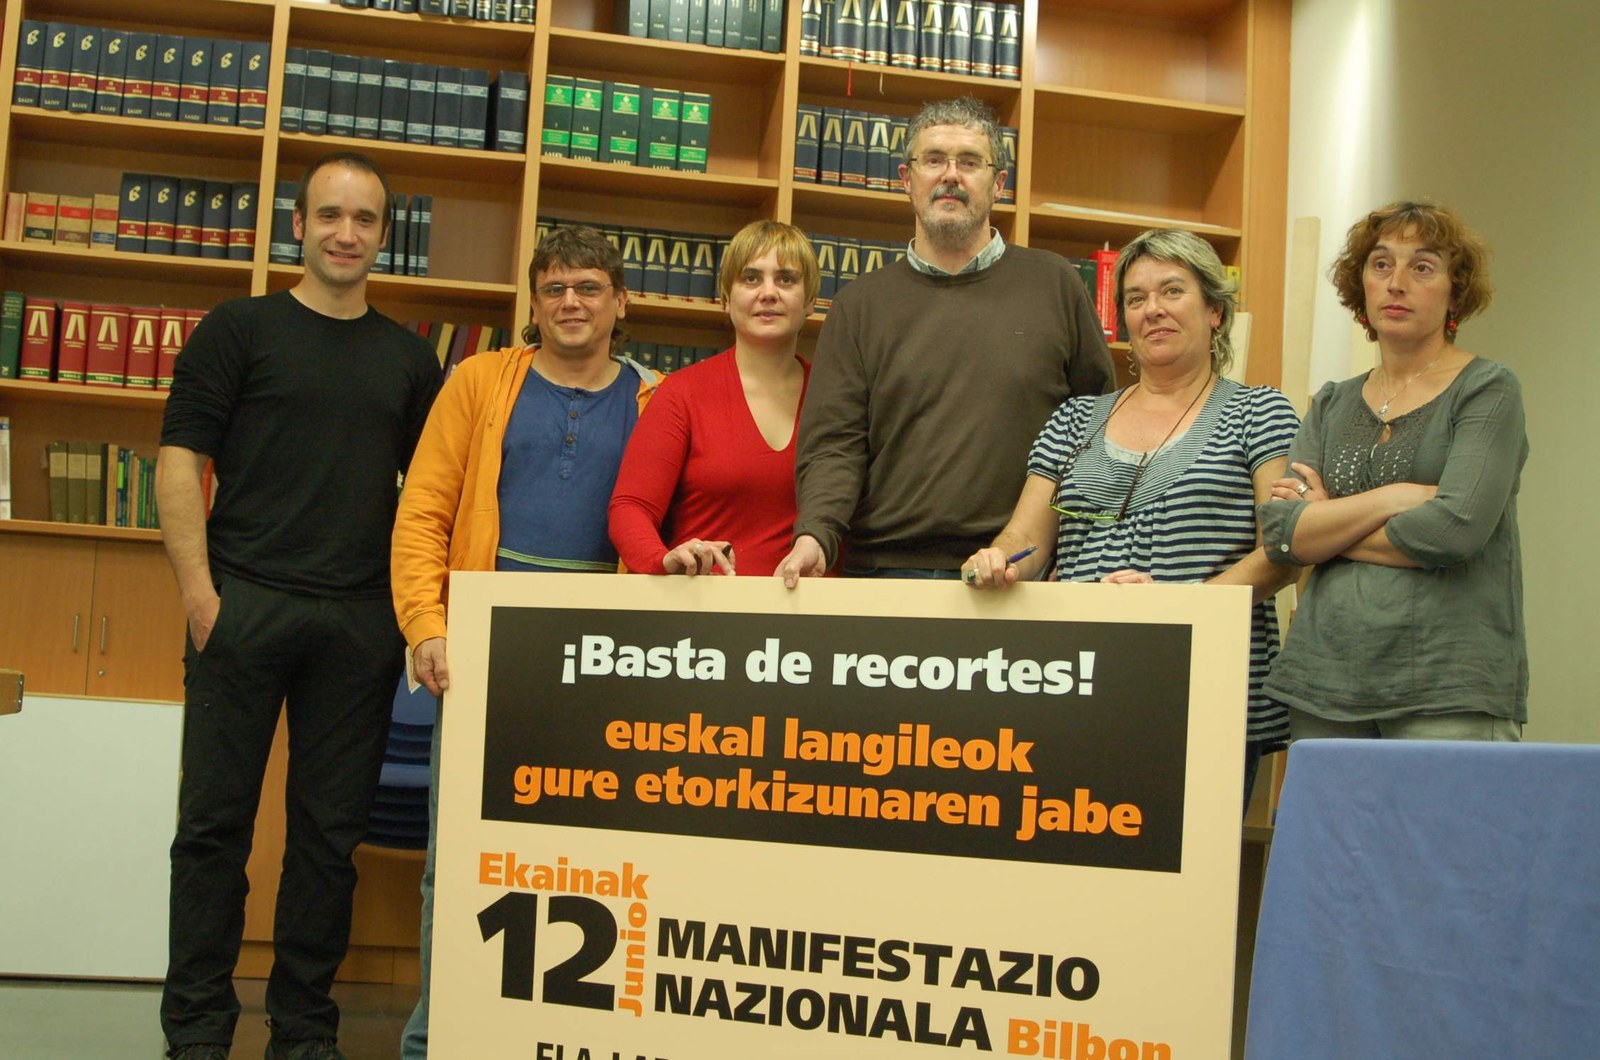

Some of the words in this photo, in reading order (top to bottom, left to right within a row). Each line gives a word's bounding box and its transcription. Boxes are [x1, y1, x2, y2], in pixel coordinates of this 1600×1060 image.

[561, 635, 726, 684] ¡Basta
[745, 638, 812, 685] de
[832, 647, 1096, 696] recortes!
[605, 713, 765, 757] euskal
[784, 718, 1034, 776] langileok
[514, 765, 619, 805] gure
[635, 766, 1000, 827] etorkizunaren
[1016, 785, 1142, 841] jabe
[478, 852, 649, 900] Ekainak
[476, 891, 618, 1012] 12
[618, 901, 648, 1018] Junio
[657, 917, 1100, 1001] MANIFESTAZIO
[654, 972, 993, 1052] NAZIONALA
[1007, 1018, 1172, 1060] Bilbon
